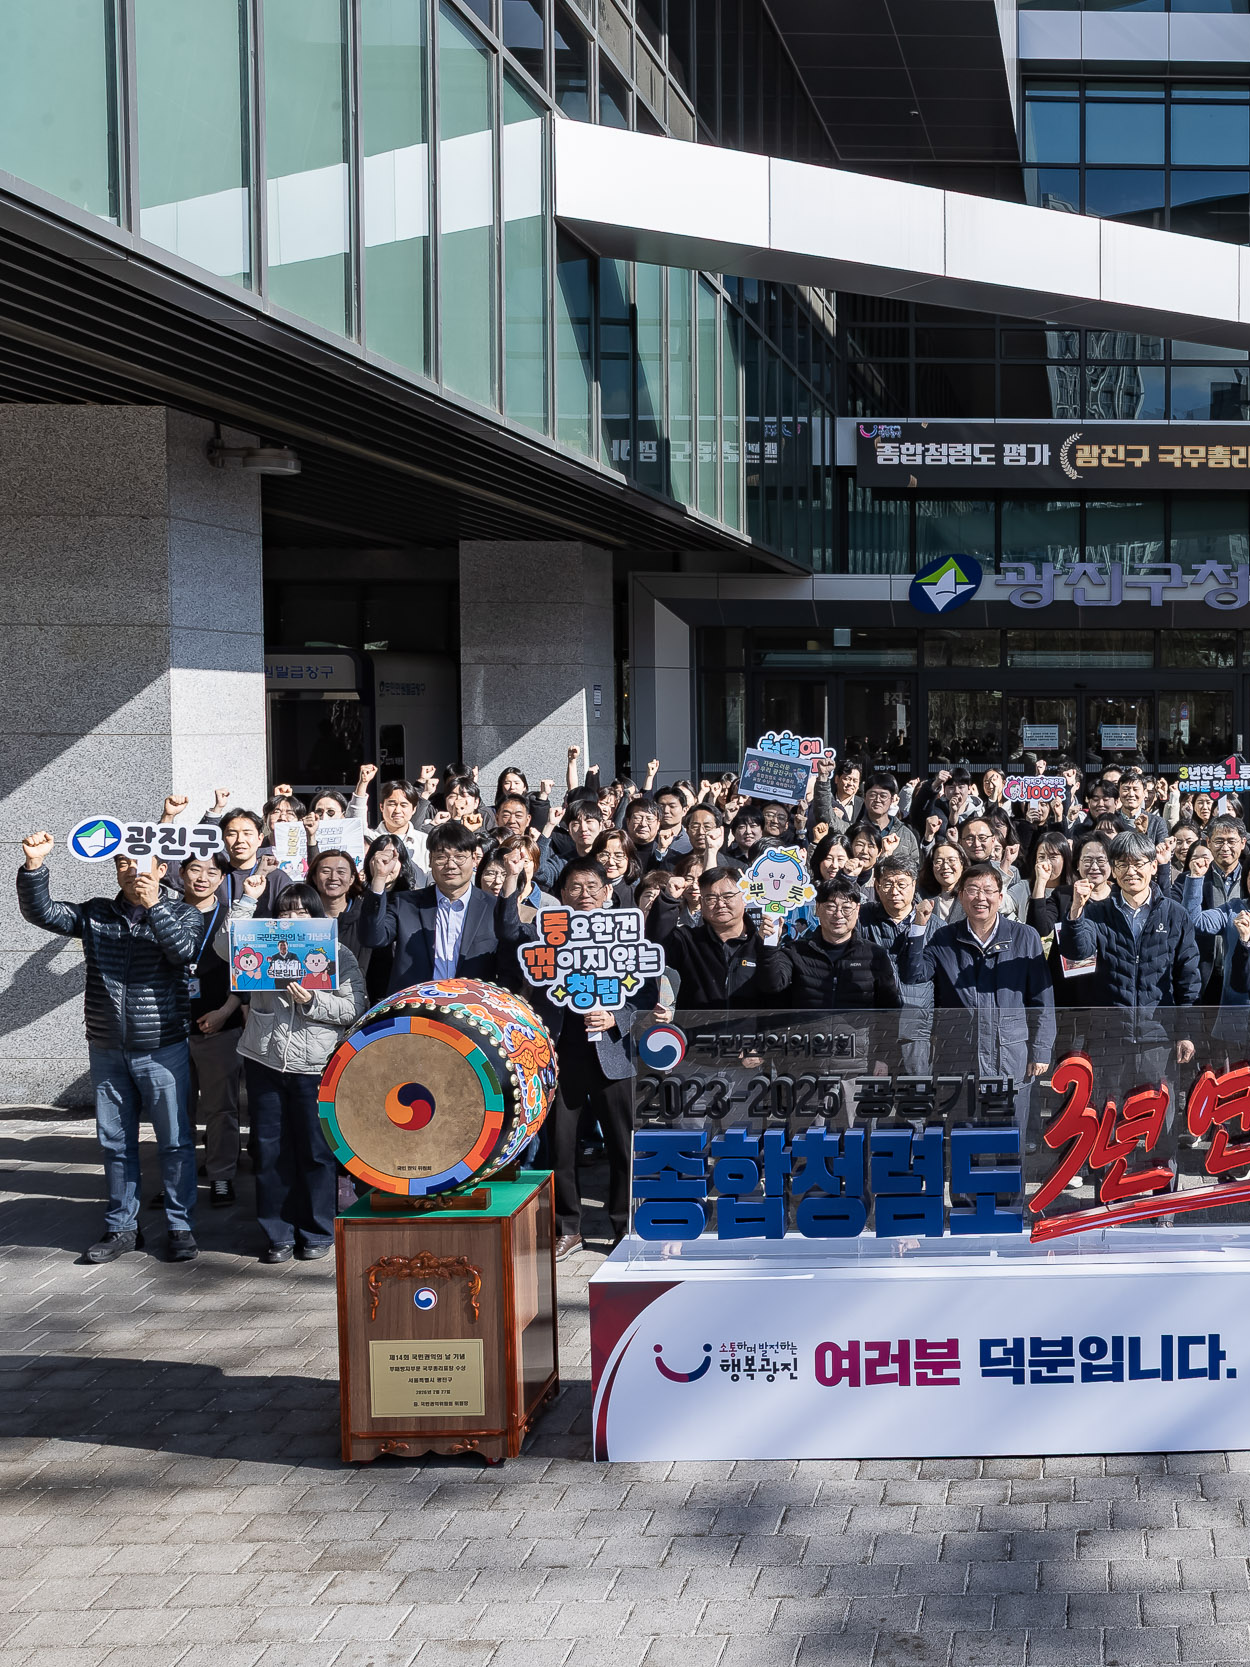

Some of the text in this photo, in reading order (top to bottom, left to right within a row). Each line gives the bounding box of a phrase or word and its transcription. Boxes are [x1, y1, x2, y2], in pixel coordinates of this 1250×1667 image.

[876, 442, 996, 466] 종합청렴도
[1003, 443, 1051, 466] 평가
[1075, 444, 1150, 468] 광진구
[995, 559, 1250, 610] 광진구청
[1179, 780, 1211, 792] 여러분
[125, 826, 220, 857] 광진구
[543, 912, 637, 945] 중요한건
[267, 969, 307, 977] 덕분입니다
[524, 946, 658, 979] 꺾이지 않는
[566, 973, 619, 1008] 청렴
[695, 1033, 857, 1058] 국민권익위원회
[636, 1073, 1018, 1120] 2023-2025 공공기관
[633, 1125, 1024, 1241] 종합청렴도
[719, 1341, 798, 1358] 소통하며 발전하는
[814, 1338, 961, 1387] 여러분
[979, 1333, 1237, 1385] 덕분입니다.
[719, 1356, 798, 1383] 행복광진
